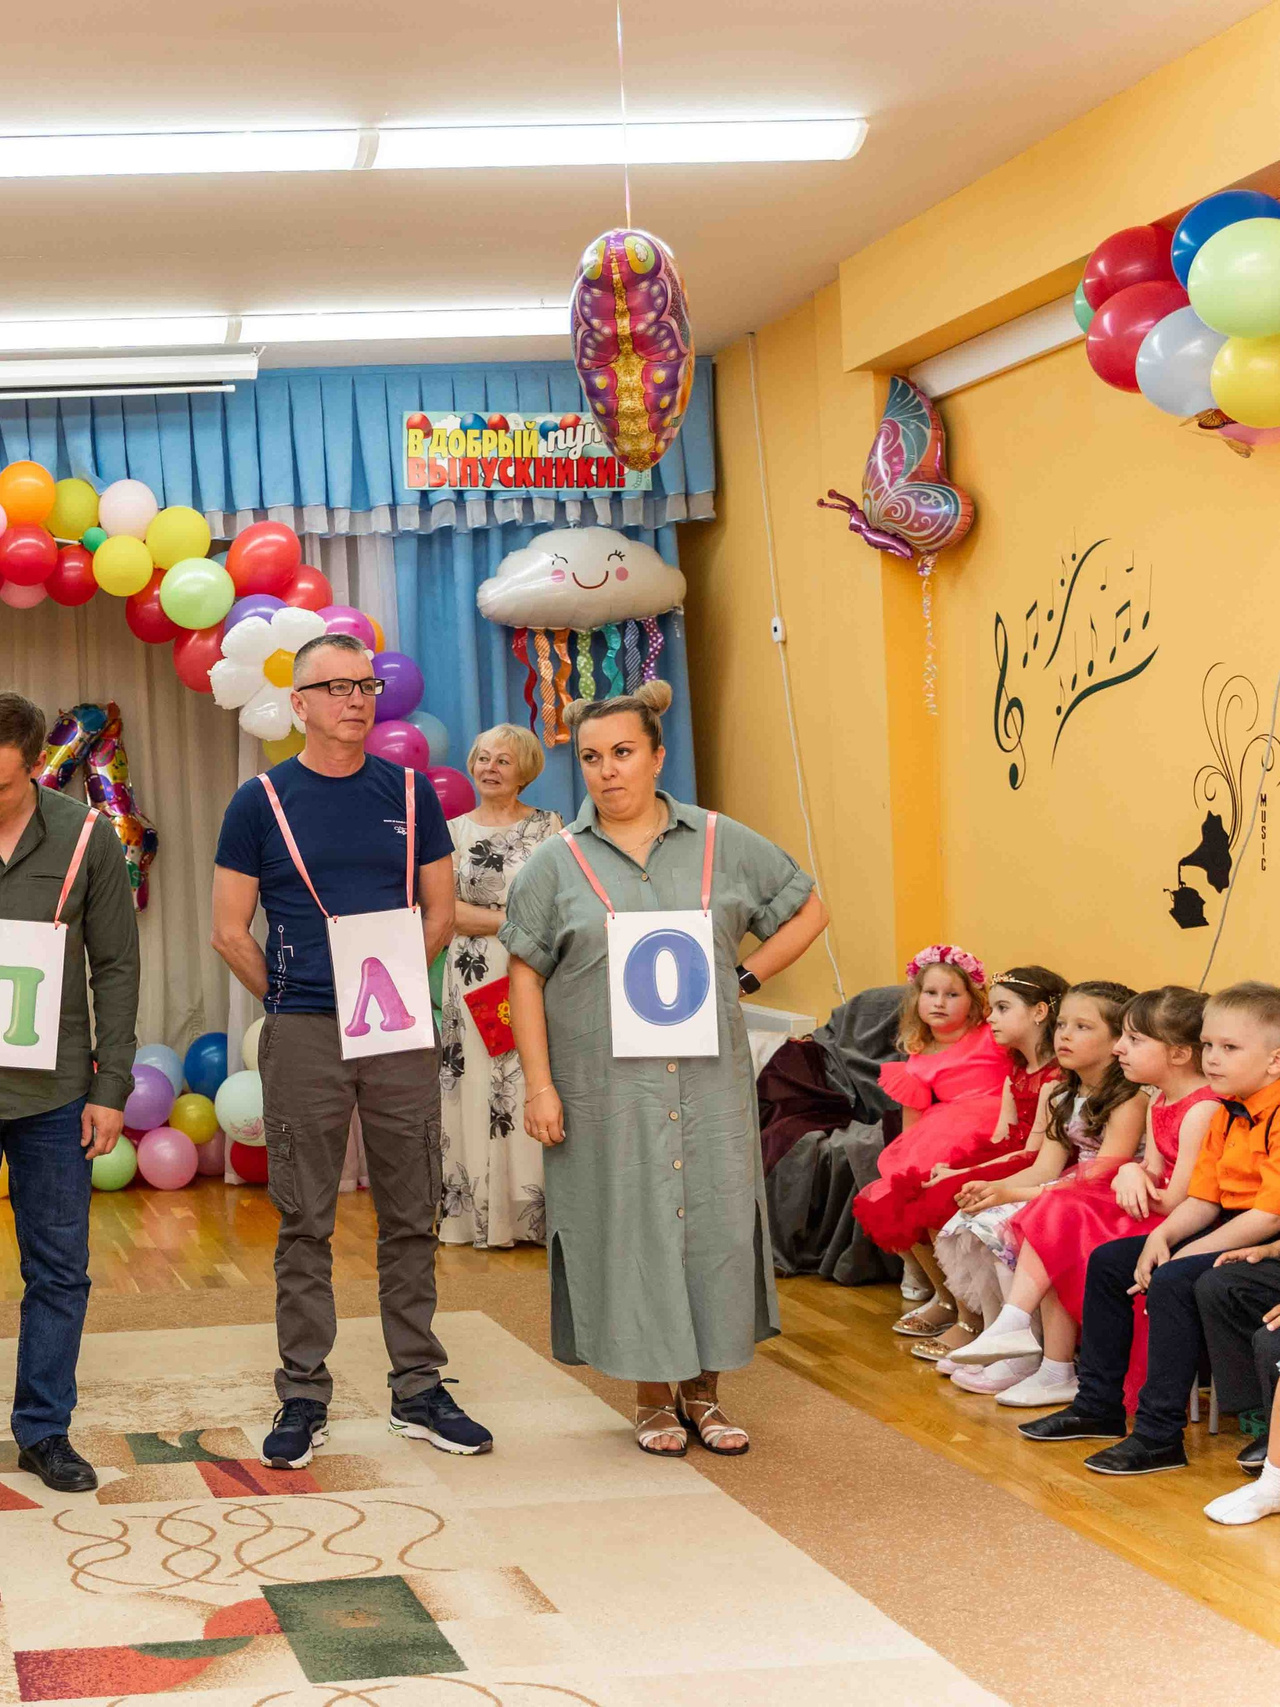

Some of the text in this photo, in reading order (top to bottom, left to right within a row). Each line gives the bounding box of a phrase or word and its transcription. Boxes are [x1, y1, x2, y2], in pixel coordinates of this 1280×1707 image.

[407, 428, 426, 458] В
[428, 421, 539, 459] ДОБРЫЙ
[407, 456, 626, 489] ВЫПУСКНИКИ!
[344, 956, 416, 1038] Л
